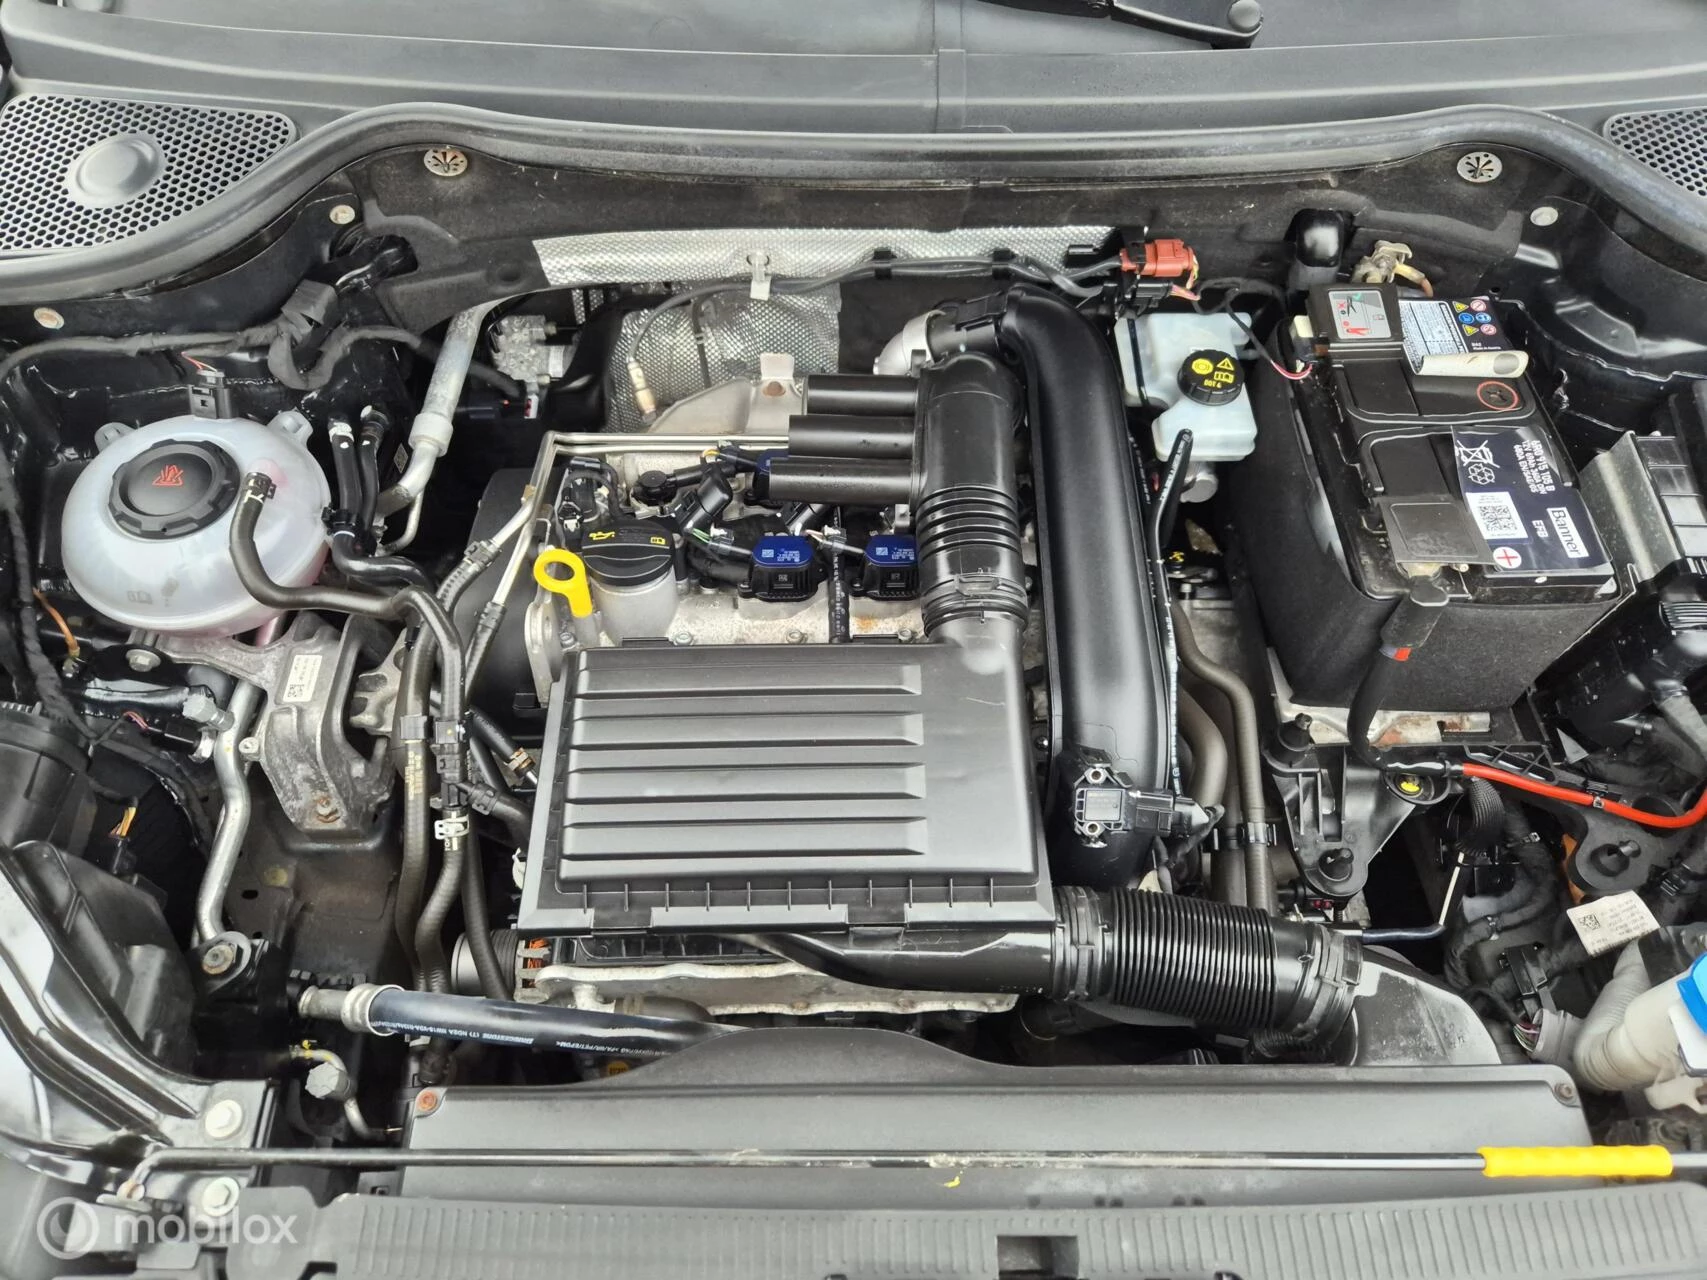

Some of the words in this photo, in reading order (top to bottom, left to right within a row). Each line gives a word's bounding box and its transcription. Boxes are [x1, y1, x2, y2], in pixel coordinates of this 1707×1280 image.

[1522, 440, 1532, 451] 12V
[1536, 456, 1549, 470] 915
[1540, 471, 1553, 484] 105
[1532, 520, 1548, 537] EFB
[1552, 510, 1580, 555] Banner
[482, 1032, 534, 1045] BRIDGESTONE
